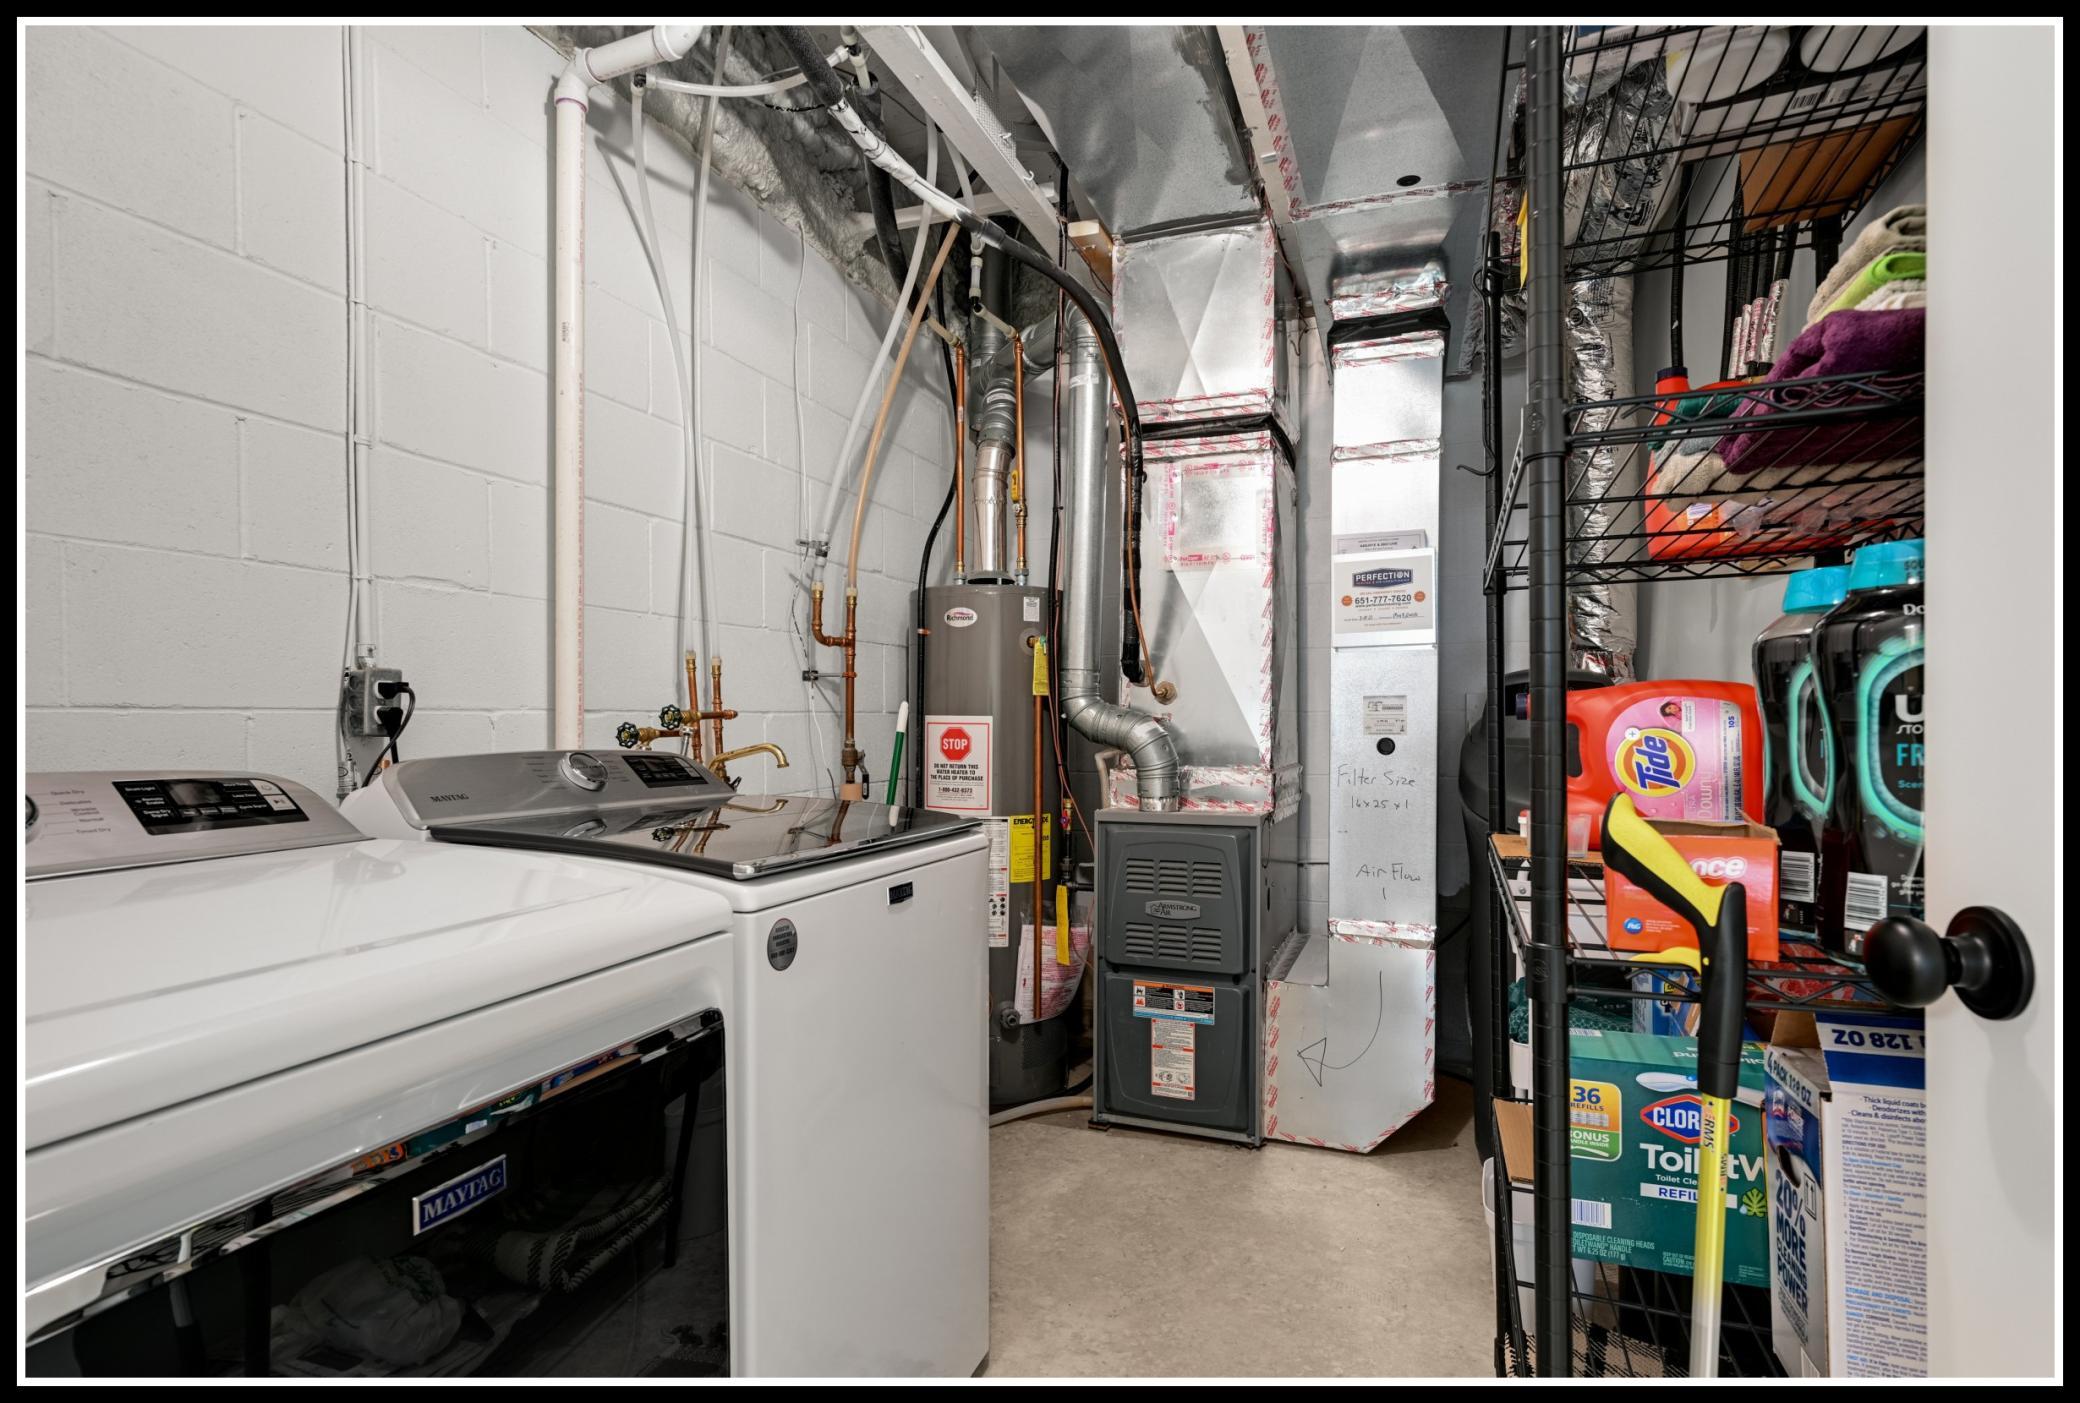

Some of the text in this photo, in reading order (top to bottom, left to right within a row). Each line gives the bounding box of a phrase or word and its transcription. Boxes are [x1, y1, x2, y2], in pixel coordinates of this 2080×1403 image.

[1355, 571, 1410, 582] PERFECTION
[1354, 594, 1412, 604] 651-777-7620
[946, 613, 974, 622] Richmond
[942, 738, 968, 751] STOP
[1634, 734, 1680, 790] Tide
[1337, 763, 1416, 787] Filter Size
[430, 793, 469, 803] MAYTAG
[1356, 863, 1421, 881] Air Flow
[1692, 857, 1746, 878] nce
[1832, 1029, 1865, 1047] OZ
[1773, 1060, 1788, 1085] PACK
[1573, 1086, 1601, 1105] 36
[1570, 1103, 1604, 1111] REFILLS
[1850, 1109, 1873, 1118] Cleans
[1872, 1104, 1910, 1114] Deodorizes
[1652, 1106, 1701, 1131] CLOR
[1656, 1174, 1680, 1183] Toilet
[422, 1167, 502, 1222] MAYTAG
[1658, 1187, 1698, 1201] REFIL
[1775, 1169, 1806, 1238] 20%
[1606, 1236, 1635, 1247] CLEANING
[1635, 1240, 1656, 1250] HEADS
[1776, 1206, 1807, 1272] MORE
[1776, 1237, 1807, 1290] CLEANING
[1777, 1254, 1808, 1319] POWER
